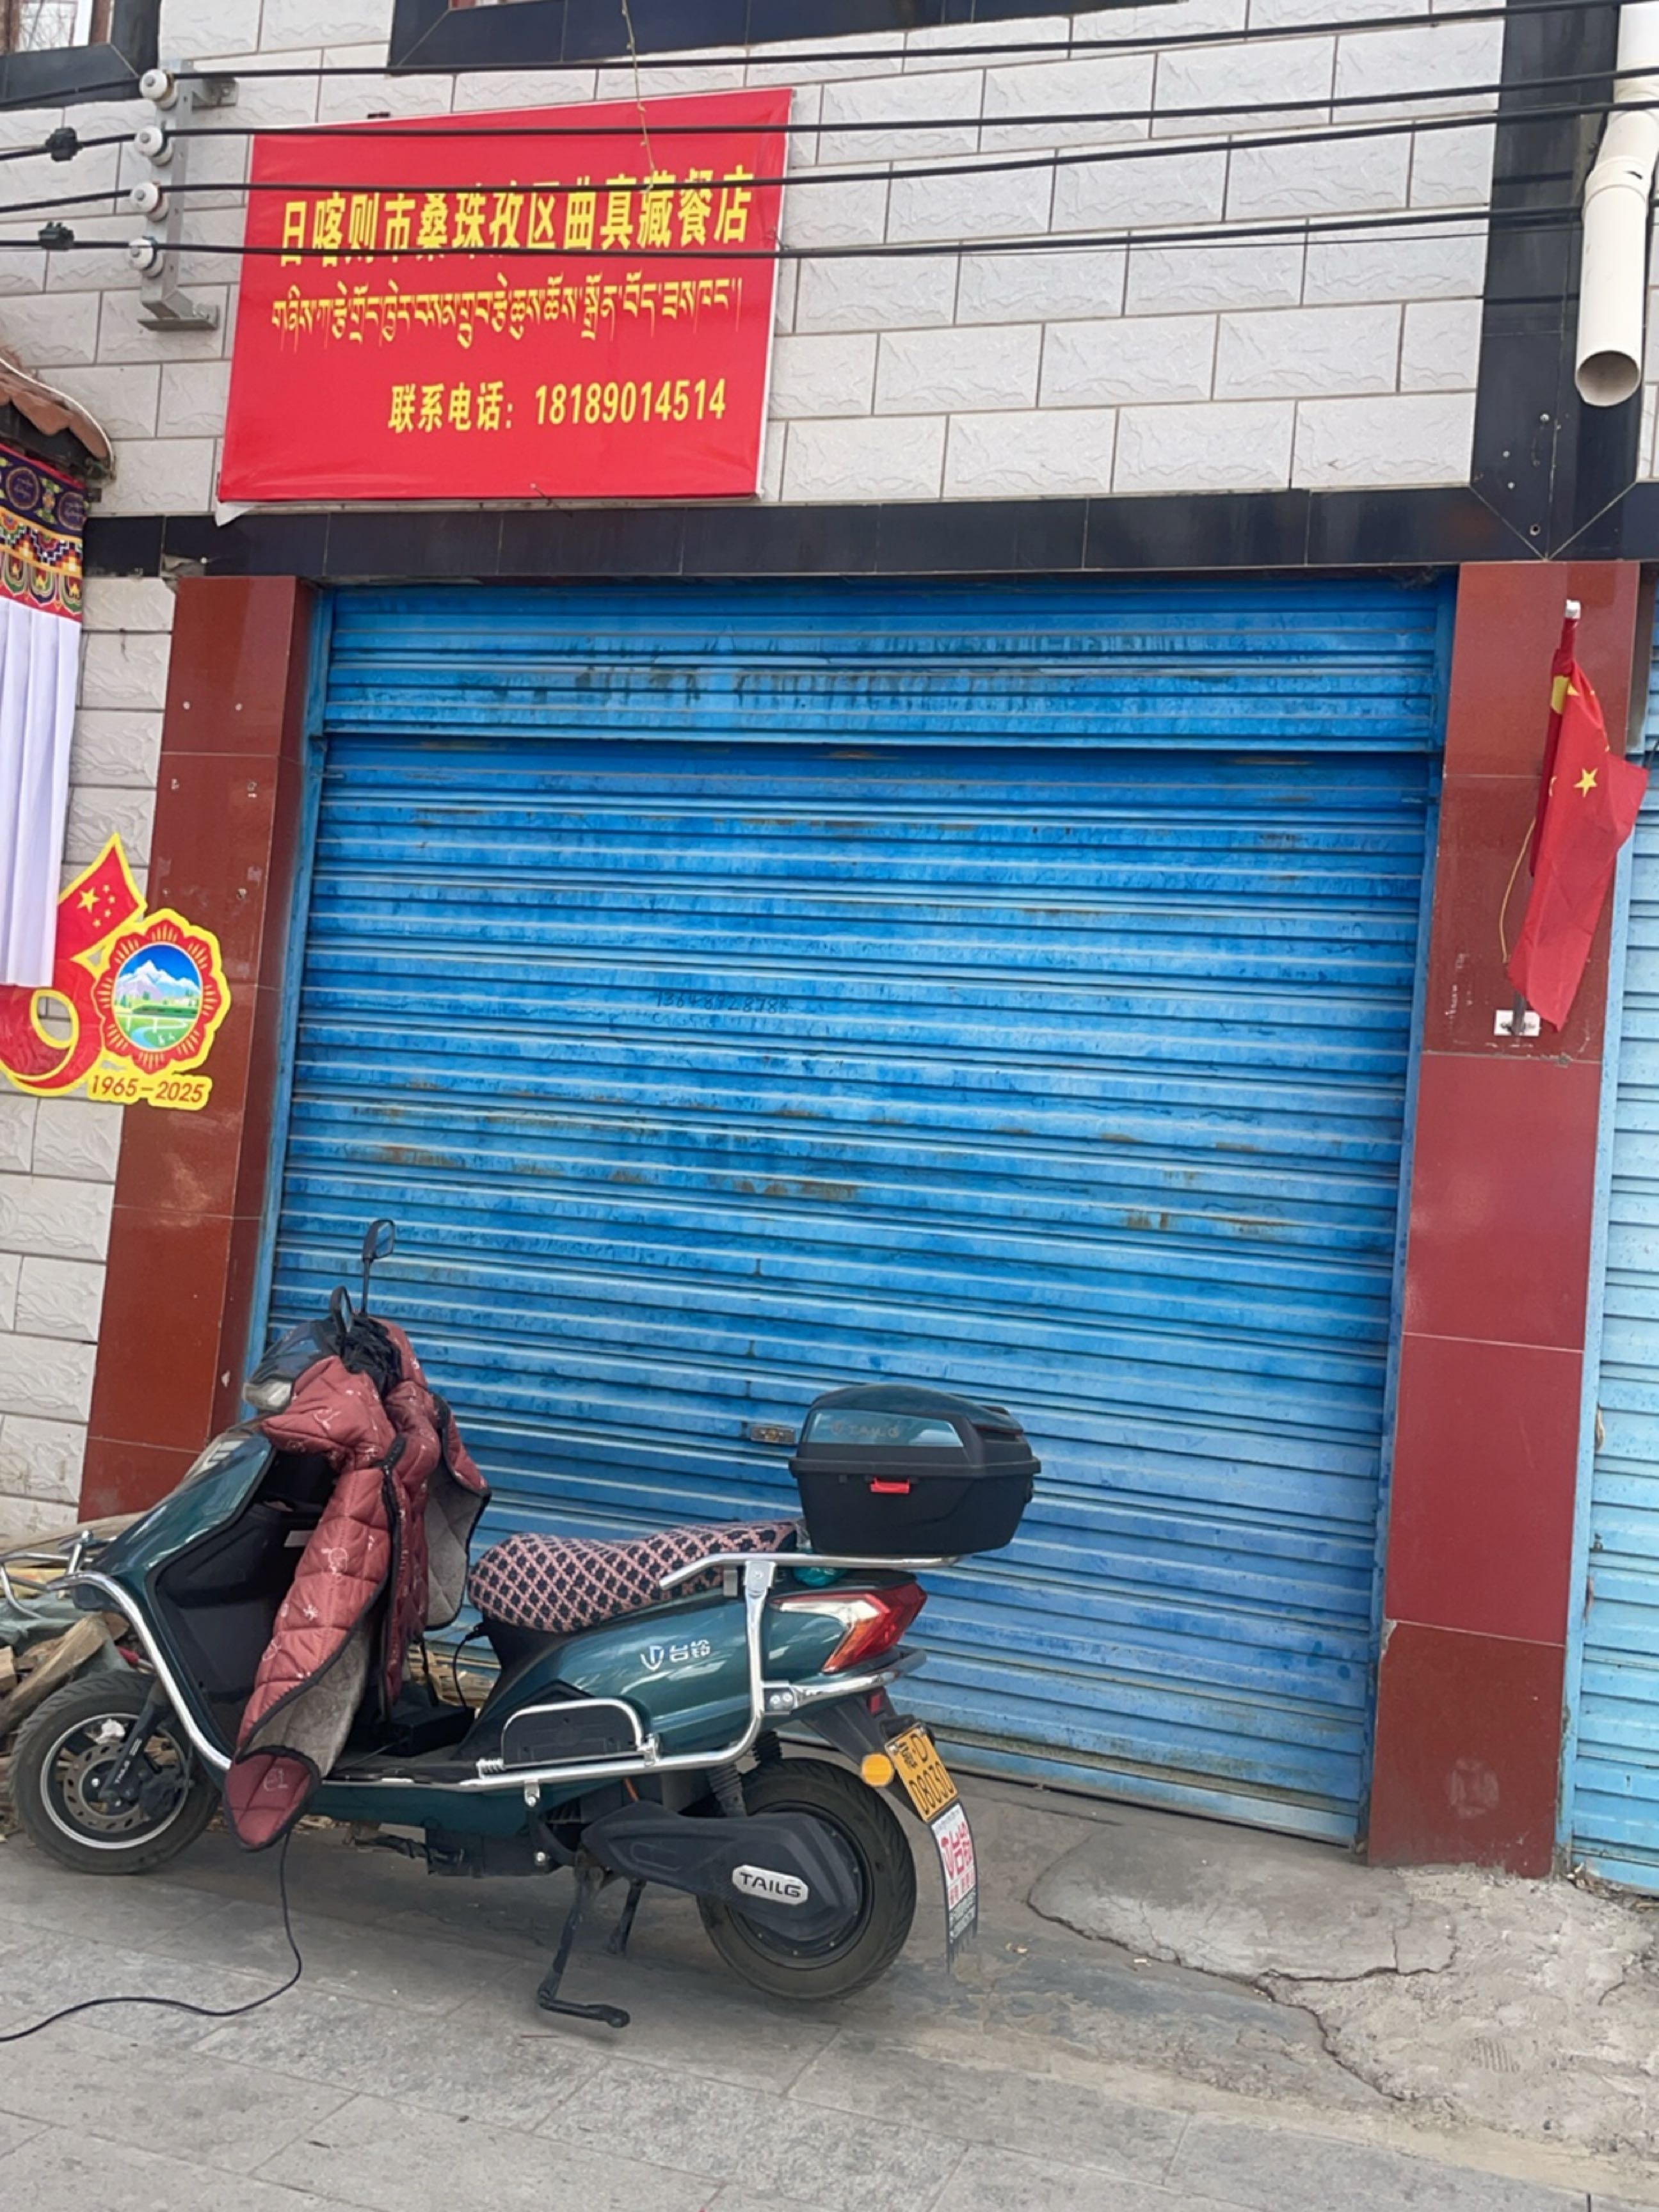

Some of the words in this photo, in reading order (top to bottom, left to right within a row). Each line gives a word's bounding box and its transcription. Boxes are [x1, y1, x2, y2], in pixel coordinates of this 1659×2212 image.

[280, 164, 754, 267] 日喀则市桑珠孜区曲真藏餐店
[535, 378, 726, 425] 18189014514
[670, 1640, 710, 1662] 台铃
[740, 1872, 801, 1898] TAILG
